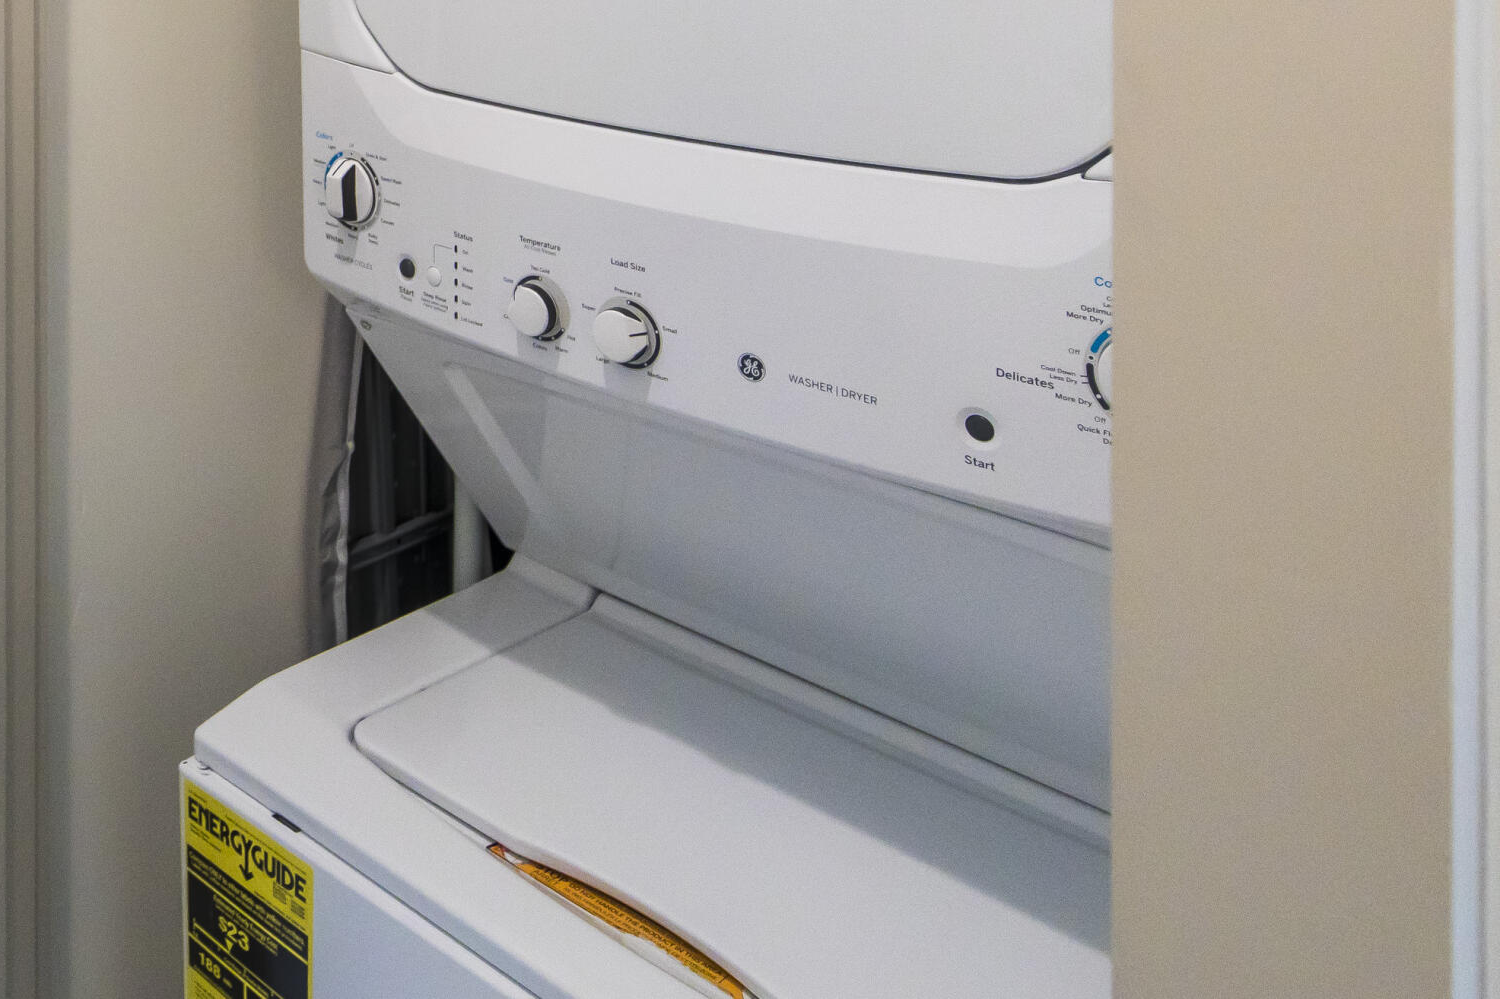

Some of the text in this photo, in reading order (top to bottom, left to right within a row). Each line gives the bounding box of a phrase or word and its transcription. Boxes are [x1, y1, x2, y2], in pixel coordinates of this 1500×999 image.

[454, 231, 473, 242] Status
[519, 235, 561, 252] Temperature
[610, 257, 646, 272] Load Size
[399, 286, 414, 296] Start
[1066, 311, 1104, 325] More Dry
[1081, 305, 1113, 316] Optimu
[662, 325, 677, 334] Small
[1040, 364, 1077, 376] Cool Down
[995, 368, 1054, 390] Delicates
[788, 374, 878, 406] WASHER DRYER
[1055, 393, 1093, 408] More Dry
[1077, 424, 1100, 435] Quick
[964, 455, 996, 471] Start
[188, 796, 307, 903] ENERGYGUIDE
[217, 915, 250, 951] $23
